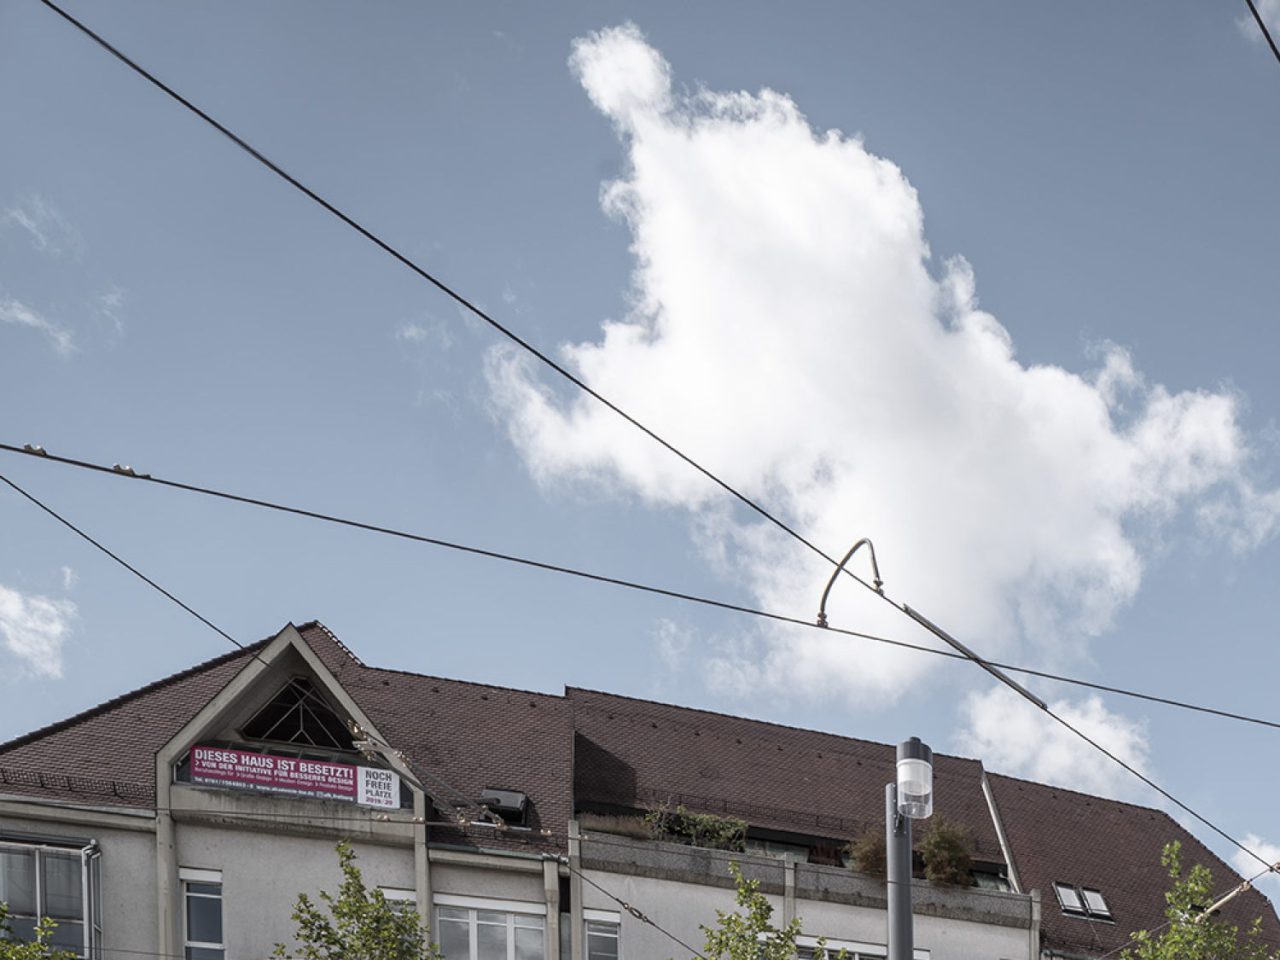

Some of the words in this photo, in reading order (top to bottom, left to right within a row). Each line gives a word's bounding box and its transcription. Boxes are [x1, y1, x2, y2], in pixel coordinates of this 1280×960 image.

[194, 749, 238, 764] DIESES
[241, 754, 274, 769] HAUS
[277, 760, 296, 771] IST
[299, 762, 354, 779] BESETZT!
[201, 760, 217, 769] VON
[235, 765, 272, 776] INITIATIVE
[290, 771, 326, 782] BESSERES
[327, 777, 354, 785] DESIGN
[365, 770, 393, 782] NOCH
[365, 780, 393, 791] FREIE
[365, 789, 393, 799] PLÄTZE
